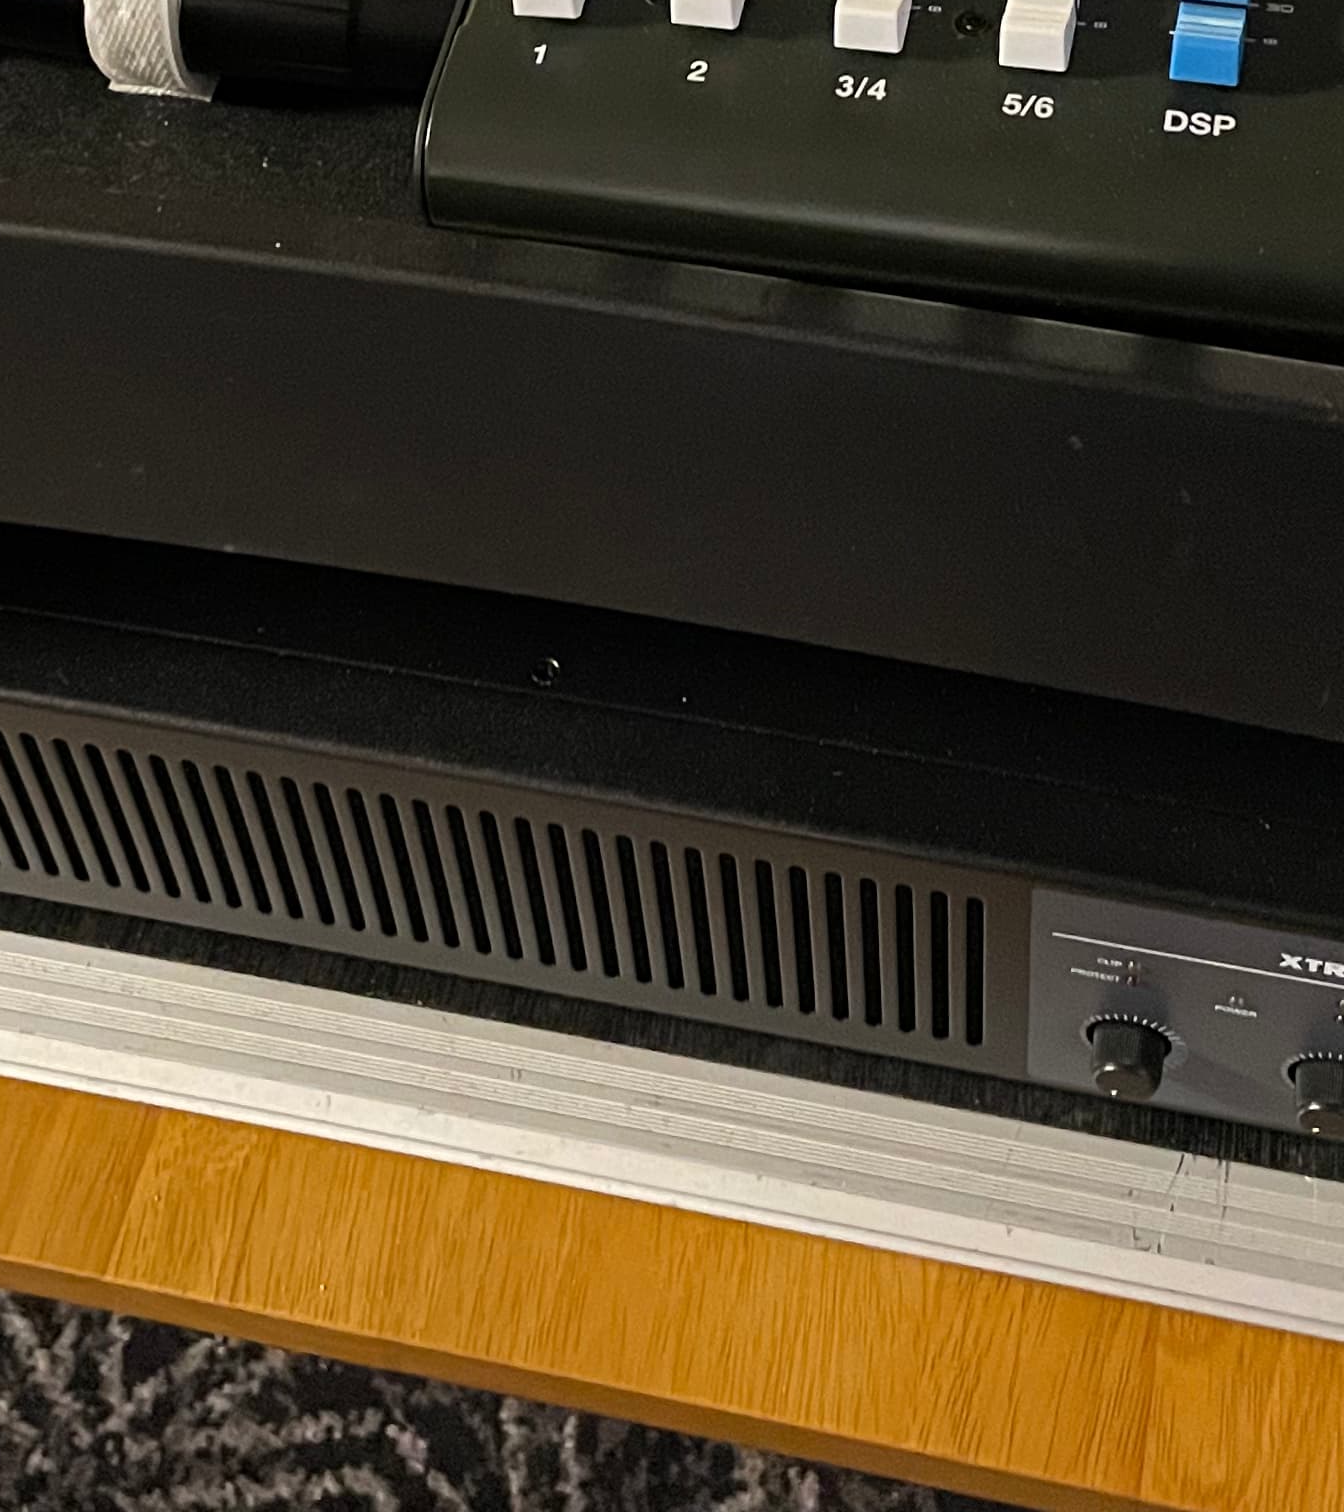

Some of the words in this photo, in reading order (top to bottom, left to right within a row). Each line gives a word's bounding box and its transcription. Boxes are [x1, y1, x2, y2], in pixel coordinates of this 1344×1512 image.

[532, 43, 548, 65] 1
[686, 59, 709, 83] 2
[834, 74, 888, 101] 3/4
[1001, 92, 1055, 119] 5/6
[1162, 108, 1237, 137] DSP
